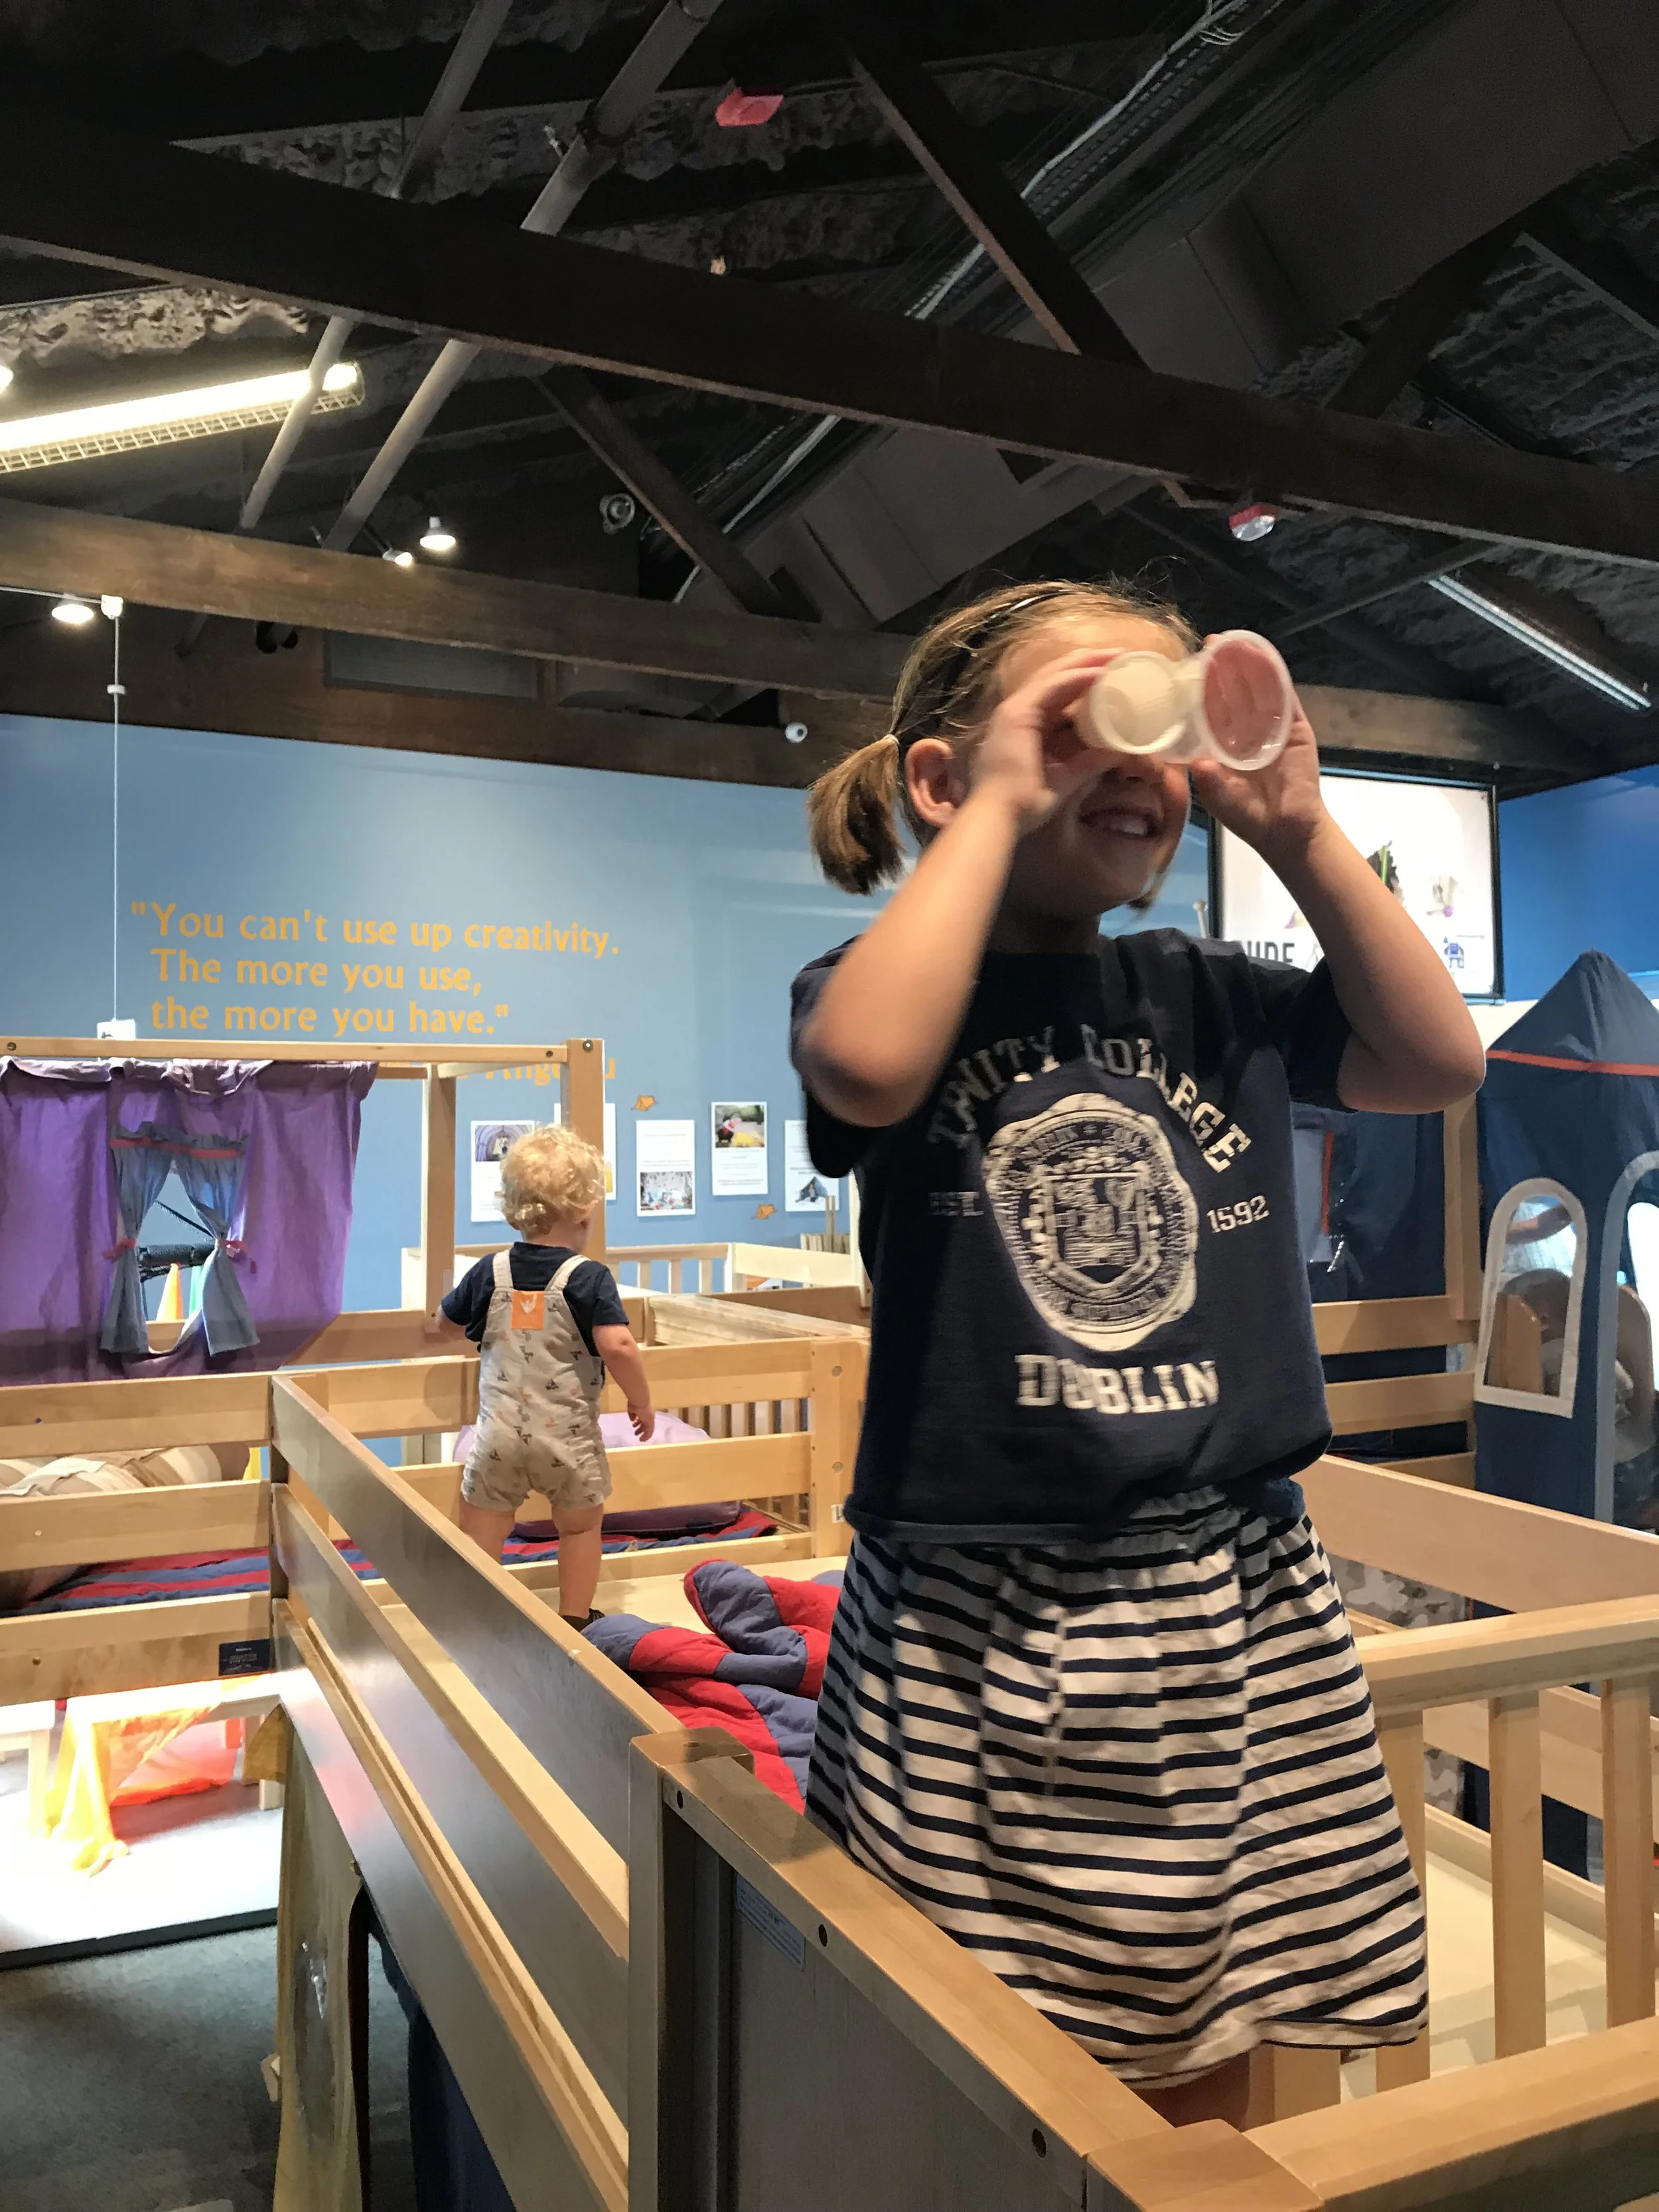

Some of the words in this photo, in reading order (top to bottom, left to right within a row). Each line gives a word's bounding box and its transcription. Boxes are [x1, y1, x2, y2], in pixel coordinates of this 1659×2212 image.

[132, 903, 223, 937] "You
[240, 910, 327, 942] can't
[344, 920, 397, 945] use
[411, 923, 452, 952] up
[465, 921, 618, 958] creativity.
[151, 948, 221, 983] The
[237, 960, 328, 986] more
[342, 964, 403, 992] you
[419, 967, 481, 995] use,
[152, 996, 208, 1029] the
[225, 1007, 317, 1031] more
[333, 1008, 394, 1036] you
[409, 1001, 508, 1034] have."
[1206, 1195, 1270, 1233] 1592
[1014, 1354, 1220, 1414] DUBLIN
